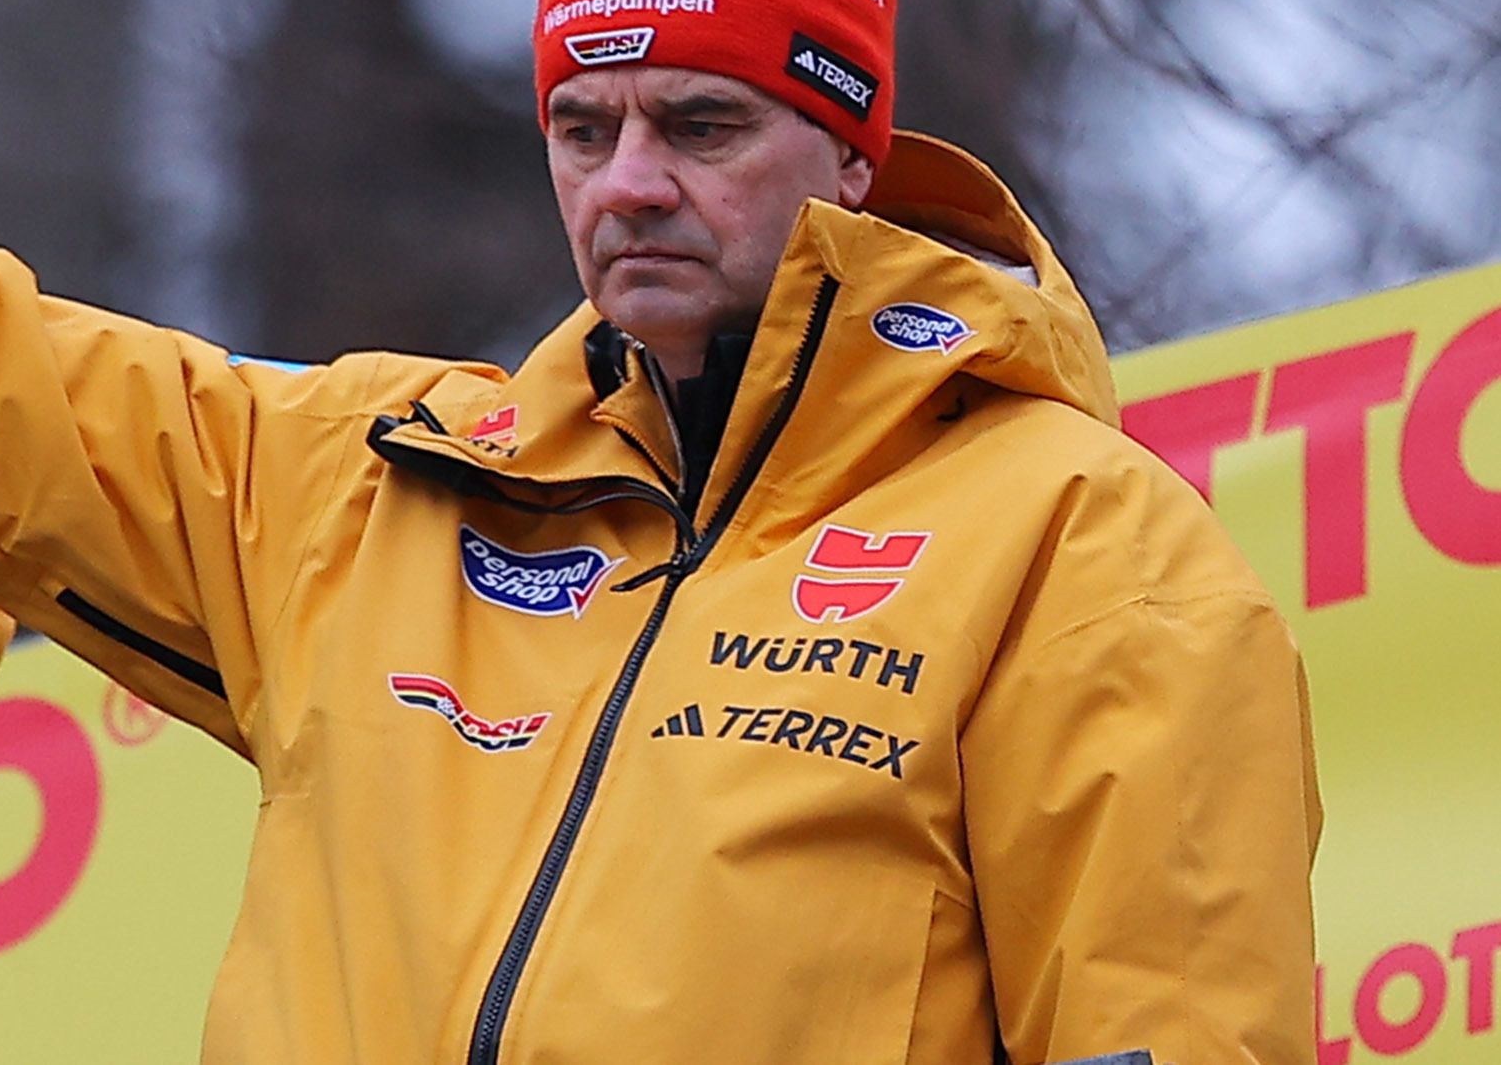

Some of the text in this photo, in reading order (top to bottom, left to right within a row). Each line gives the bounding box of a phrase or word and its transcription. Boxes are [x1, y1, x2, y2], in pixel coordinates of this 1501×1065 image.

[816, 56, 874, 108] TERREX
[877, 309, 956, 334] personal
[887, 322, 933, 345] shop
[465, 539, 595, 585] personal
[477, 572, 561, 605] shop
[709, 631, 925, 695] WÜRTH
[716, 705, 921, 779] TERREX
